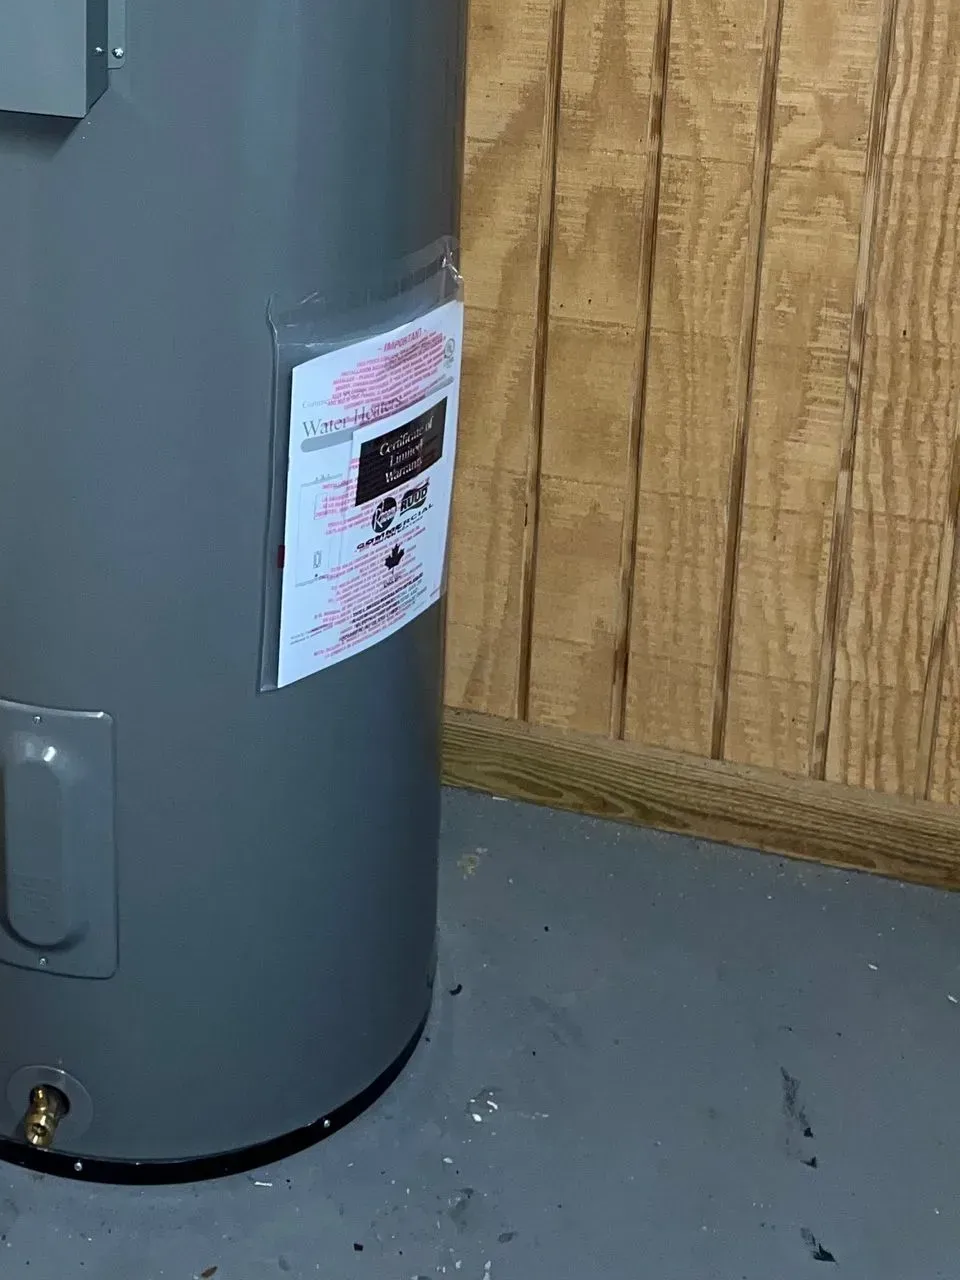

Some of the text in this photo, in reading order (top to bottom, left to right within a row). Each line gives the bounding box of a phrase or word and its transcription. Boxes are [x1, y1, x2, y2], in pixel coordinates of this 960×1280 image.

[302, 394, 402, 438] Water Heaters
[380, 416, 434, 456] Certificate of
[389, 438, 423, 467] Limited
[385, 455, 423, 483] Warranty
[400, 486, 428, 512] RUUD
[356, 503, 434, 550] COMMERCIAL
